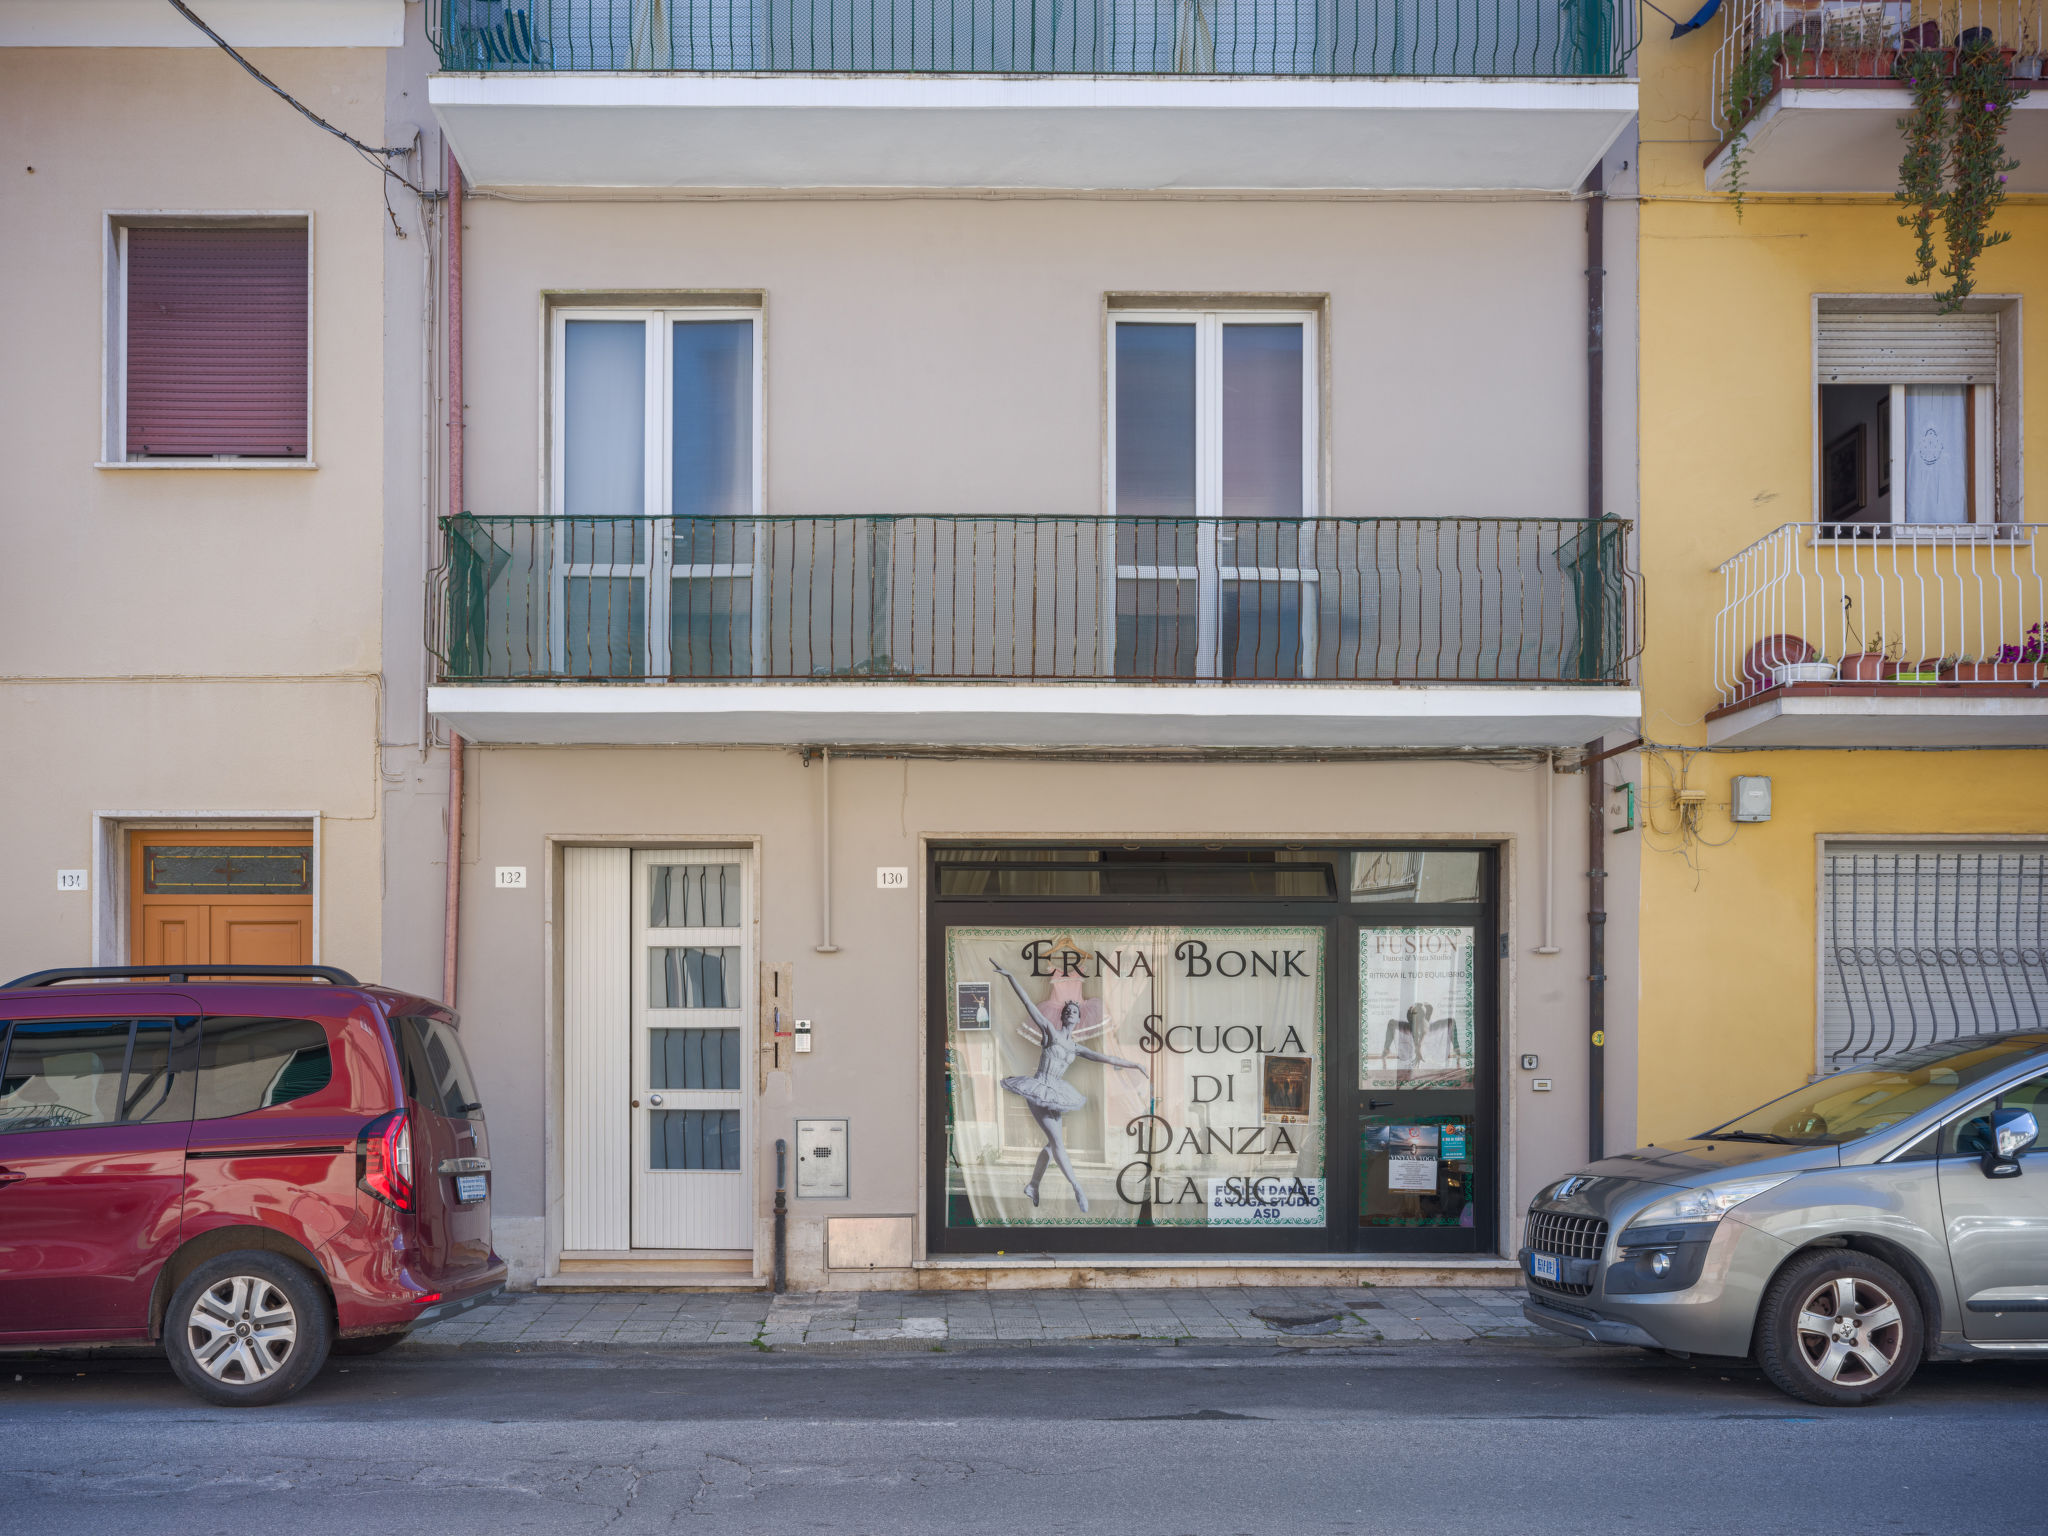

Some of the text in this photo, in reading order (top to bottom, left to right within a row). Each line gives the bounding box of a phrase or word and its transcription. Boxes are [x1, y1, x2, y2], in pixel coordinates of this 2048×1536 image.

[501, 871, 521, 884] 132
[882, 872, 903, 885] 130
[1375, 935, 1458, 954] FUSION
[1021, 939, 1310, 978] ERNA BONK
[1412, 954, 1429, 962] Yga
[1369, 971, 1399, 979] RITROVA
[1400, 971, 1407, 979] IL
[1139, 1014, 1307, 1054] SCUOLA
[1191, 1074, 1234, 1103] DI
[1126, 1114, 1298, 1155] DANZA
[1214, 1196, 1223, 1207] &
[1253, 1208, 1281, 1219] ASD
